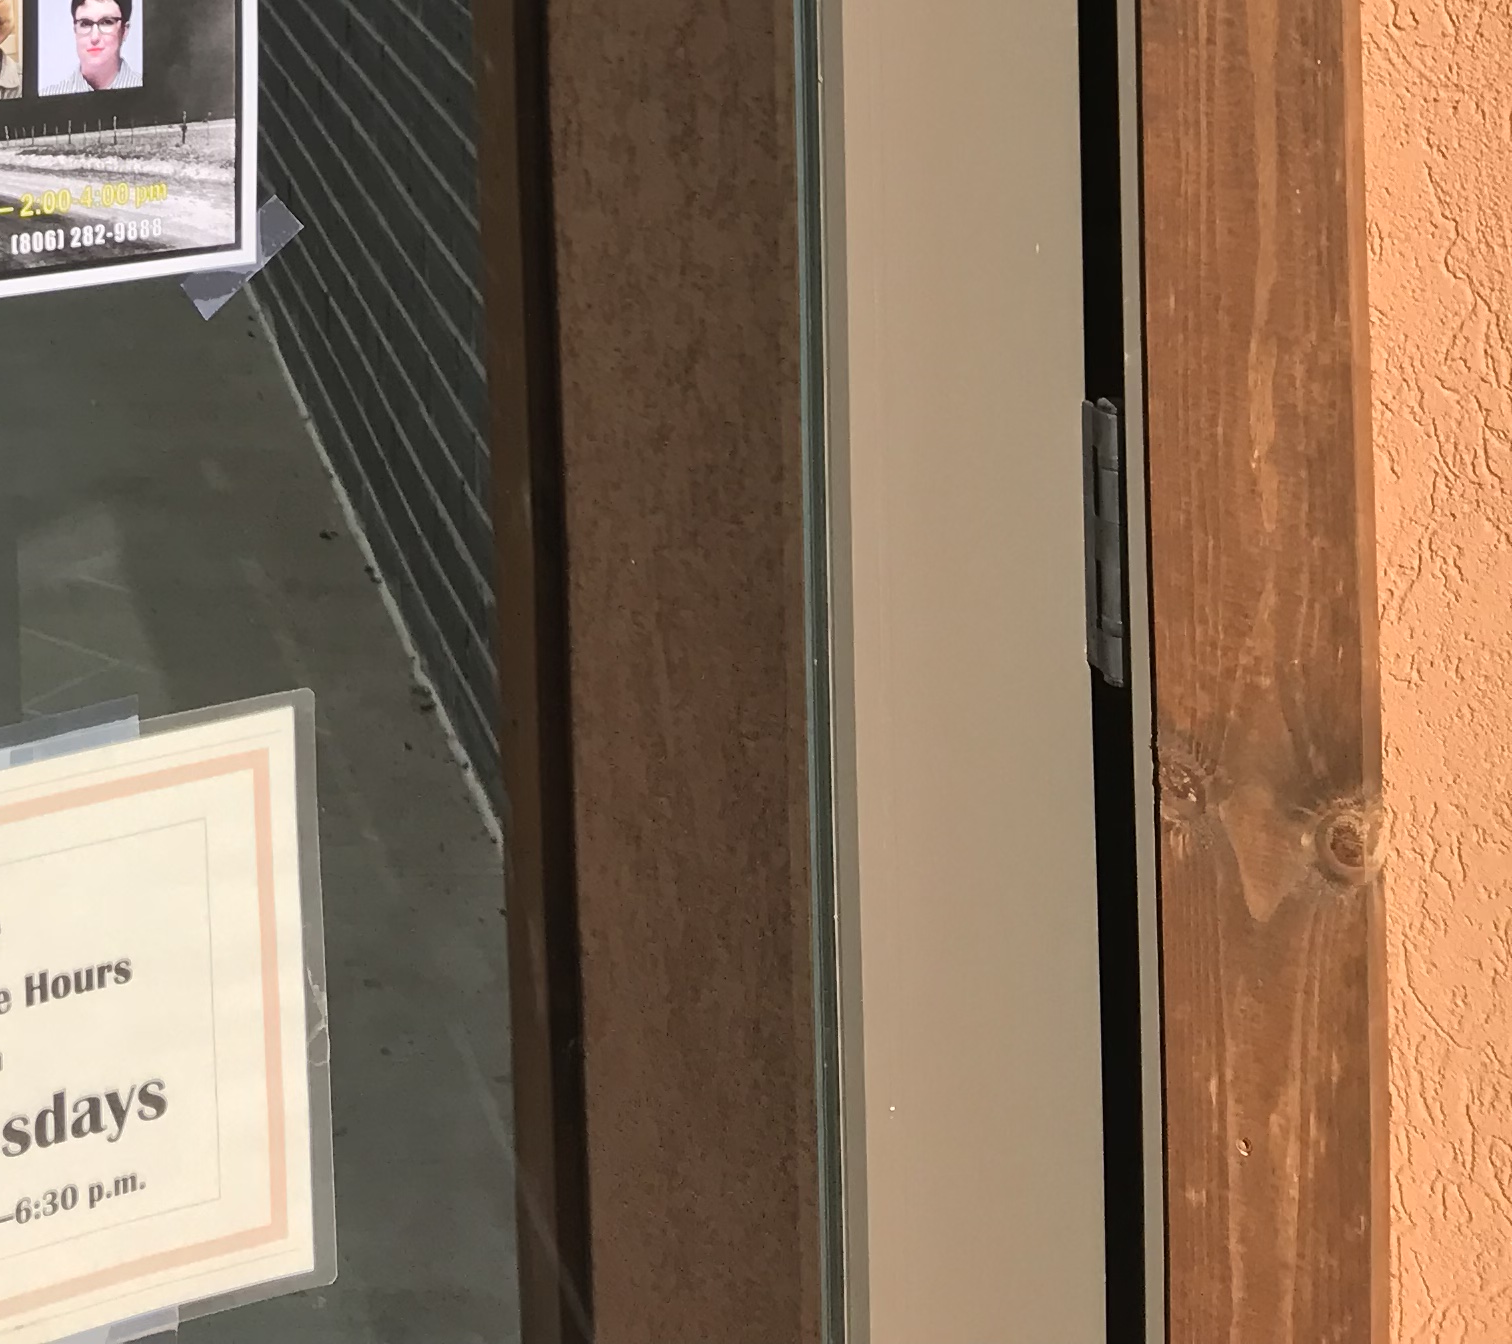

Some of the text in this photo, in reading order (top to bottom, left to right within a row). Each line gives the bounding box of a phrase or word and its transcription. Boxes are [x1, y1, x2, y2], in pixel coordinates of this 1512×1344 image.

[135, 181, 168, 208] pm
[11, 229, 65, 256] (806)
[70, 217, 163, 248] 282-9888
[25, 958, 133, 1008] Hours
[88, 1172, 147, 1209] p.m.
